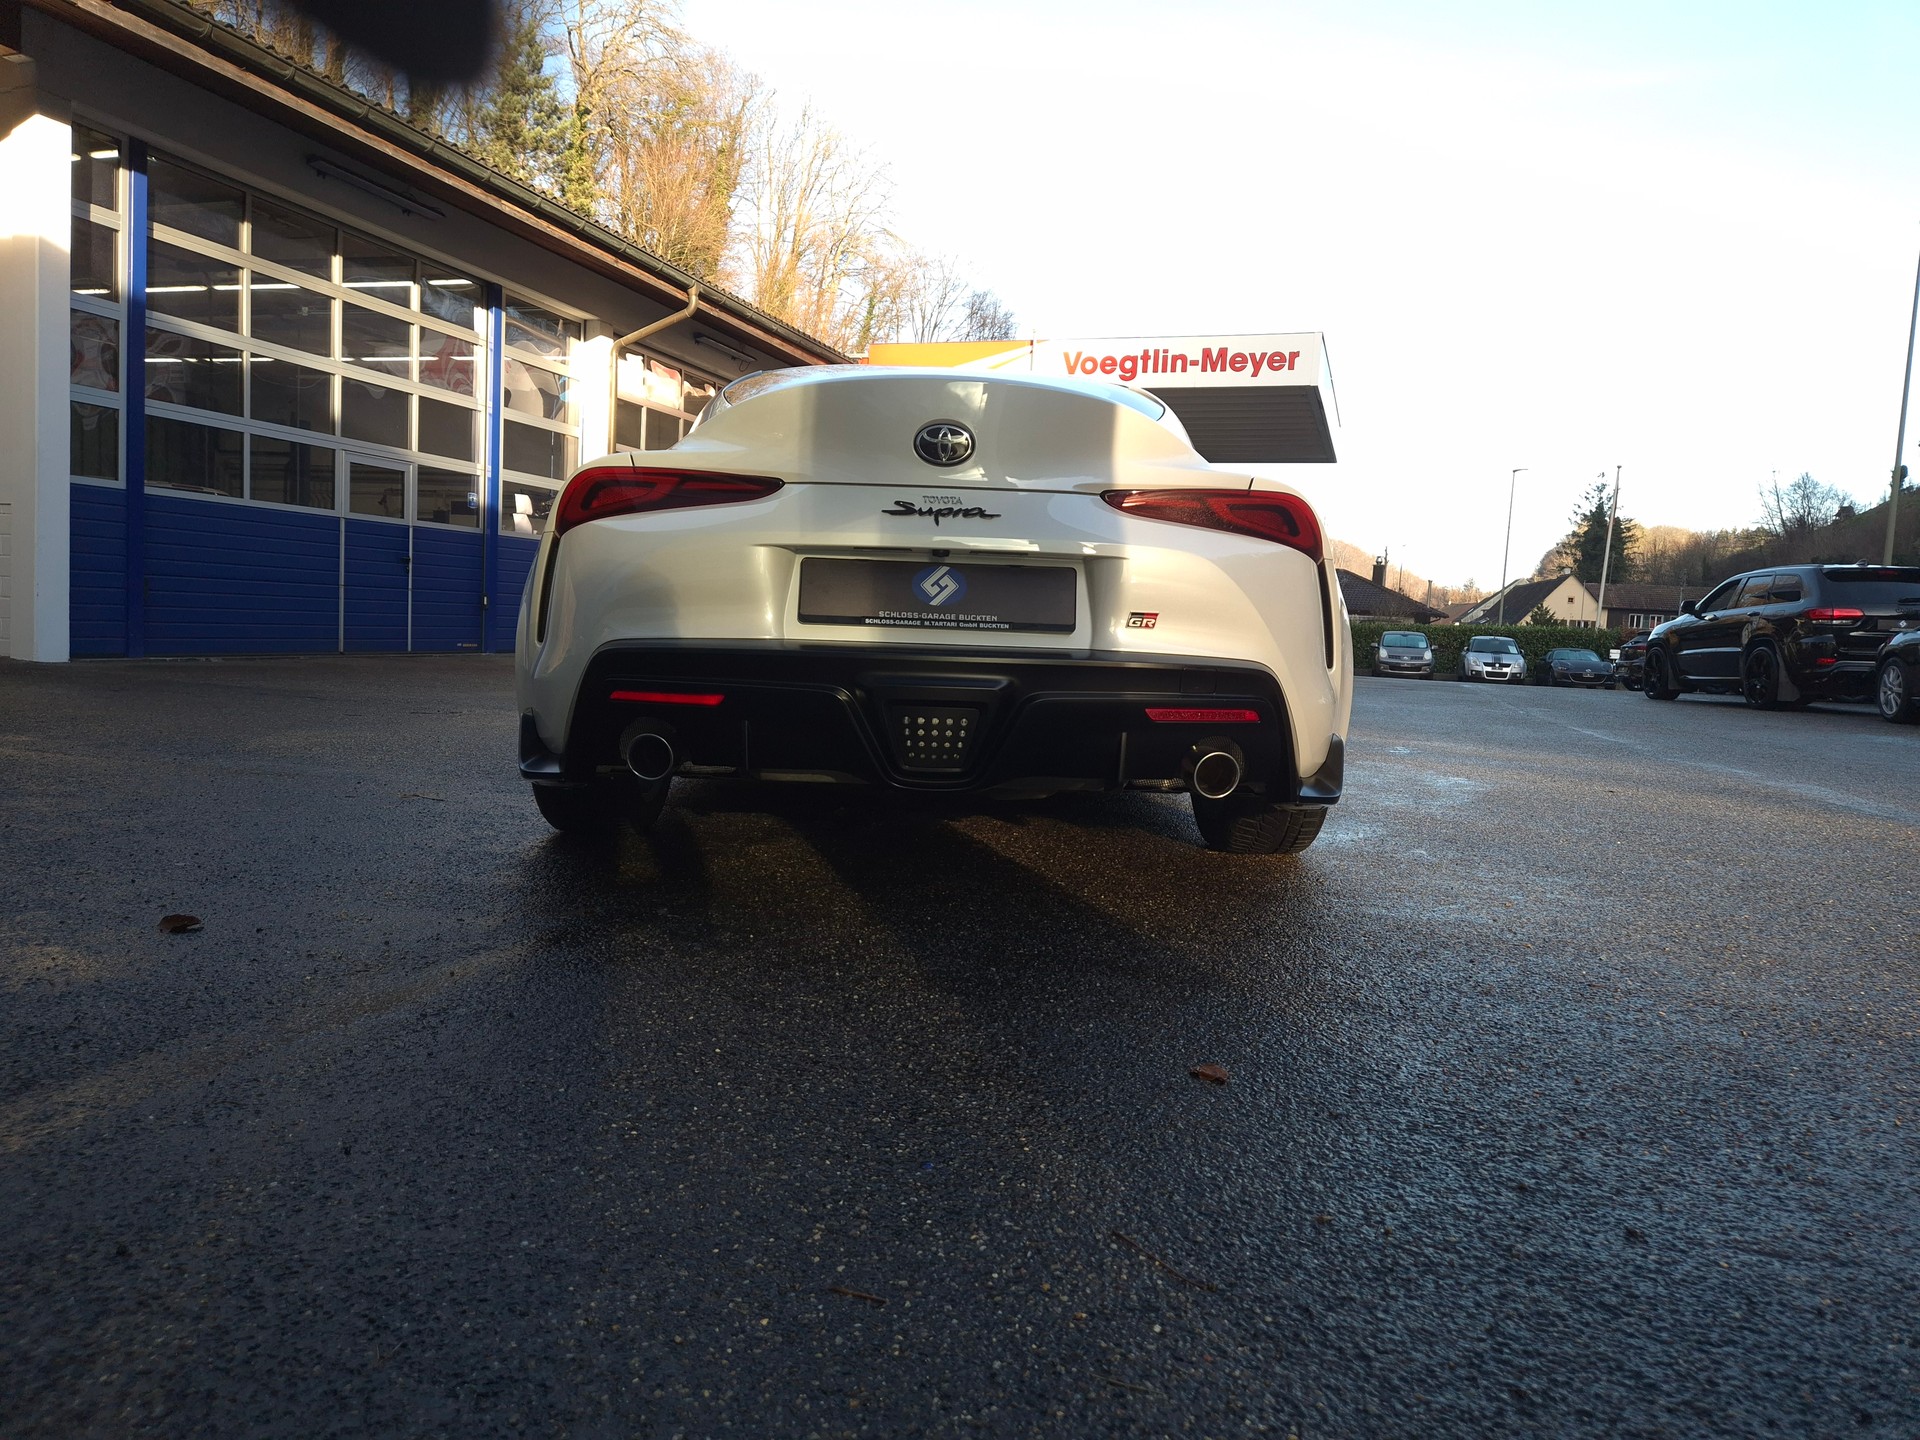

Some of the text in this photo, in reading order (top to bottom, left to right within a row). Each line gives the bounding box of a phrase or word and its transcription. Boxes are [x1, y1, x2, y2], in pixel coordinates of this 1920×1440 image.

[1063, 347, 1300, 381] Voegtlin-Meyer
[922, 495, 963, 505] TOYOTA
[881, 500, 1002, 527] Supra
[878, 610, 998, 622] SCHLOSS-GARAGE BUCKTEN
[865, 618, 921, 626] SCHLOSS-GARAGE
[1128, 617, 1156, 628] GR
